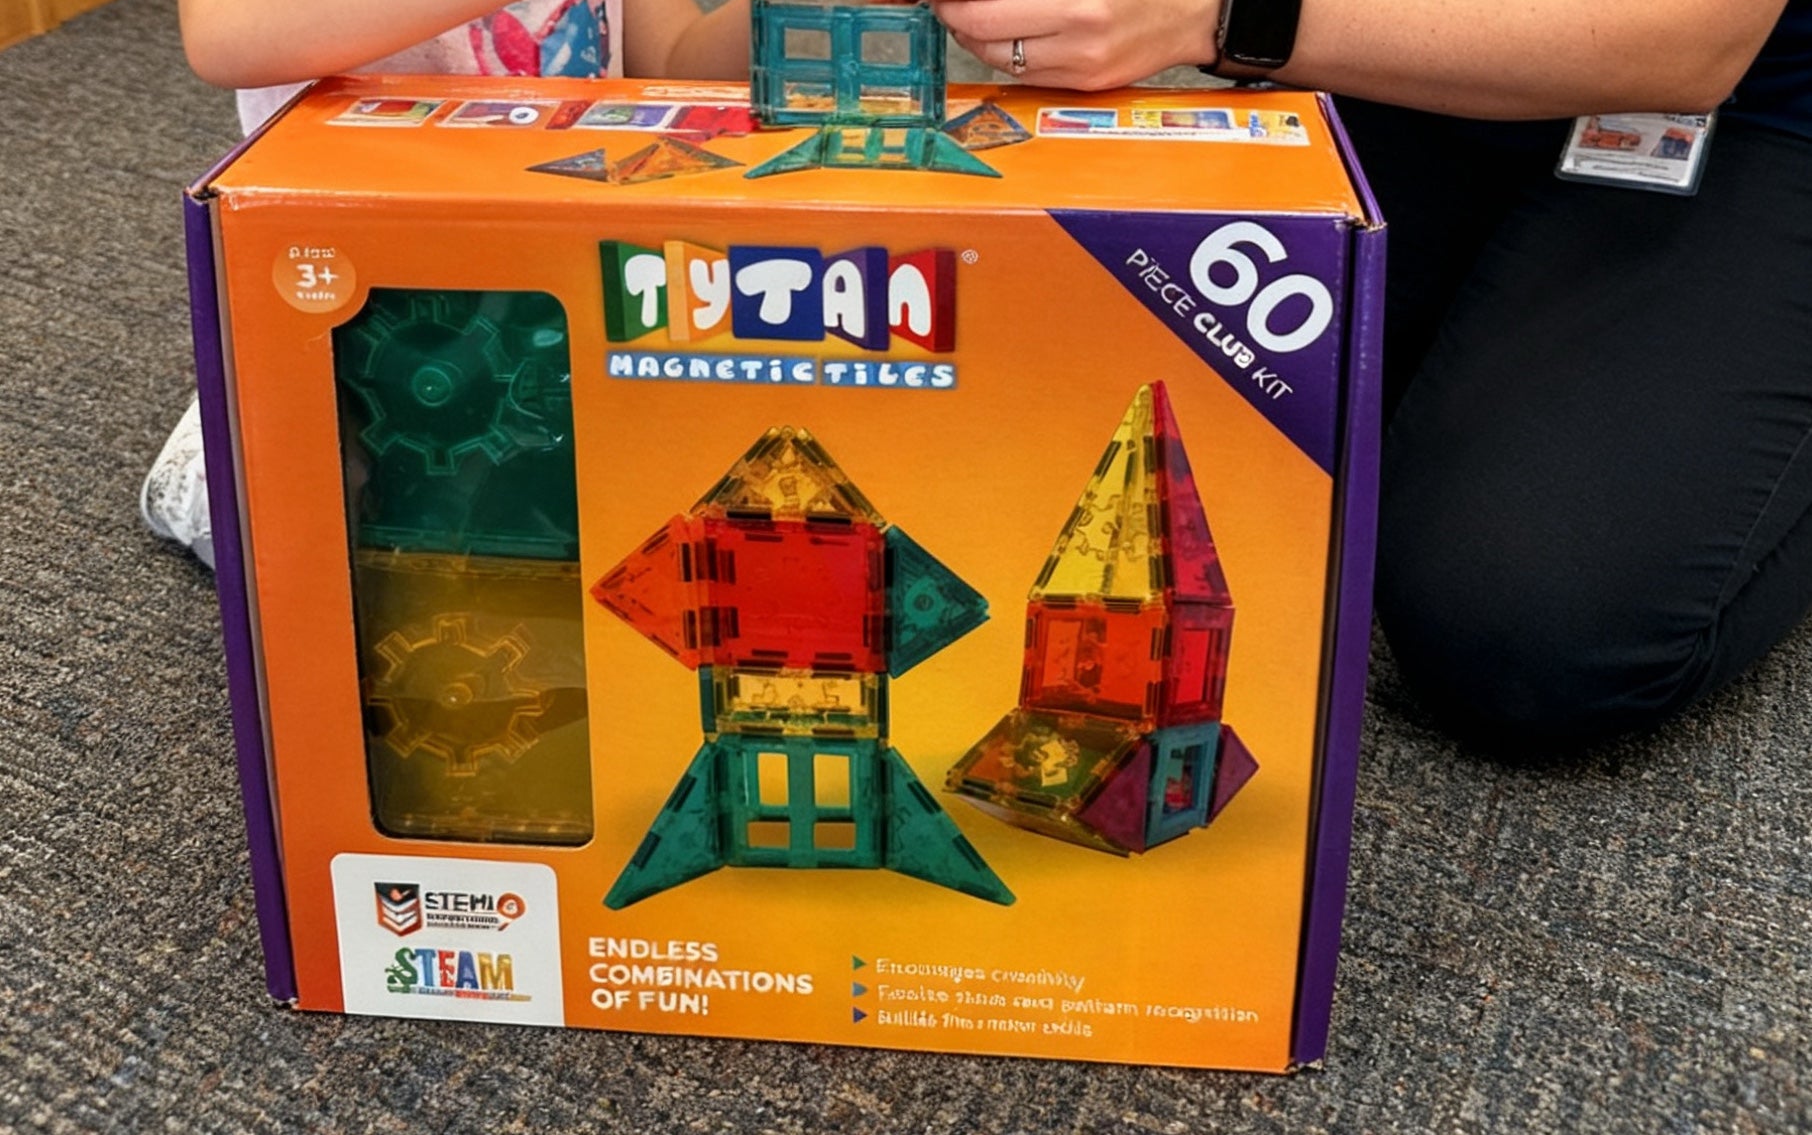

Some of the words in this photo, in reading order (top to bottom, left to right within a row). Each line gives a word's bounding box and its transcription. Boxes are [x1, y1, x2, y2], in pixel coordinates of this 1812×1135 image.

[296, 264, 339, 288] 3+
[1189, 220, 1334, 353] 60
[624, 253, 932, 339] TYTAN
[1125, 248, 1196, 318] PIECE
[1252, 366, 1293, 400] KIT
[609, 354, 814, 384] MAGNETIC
[824, 360, 954, 388] TILES
[588, 936, 719, 962] ENDLESS
[386, 947, 514, 993] STEAM
[589, 963, 814, 995] COMBINATIONS
[591, 988, 632, 1010] OF
[638, 990, 709, 1016] FUN!
